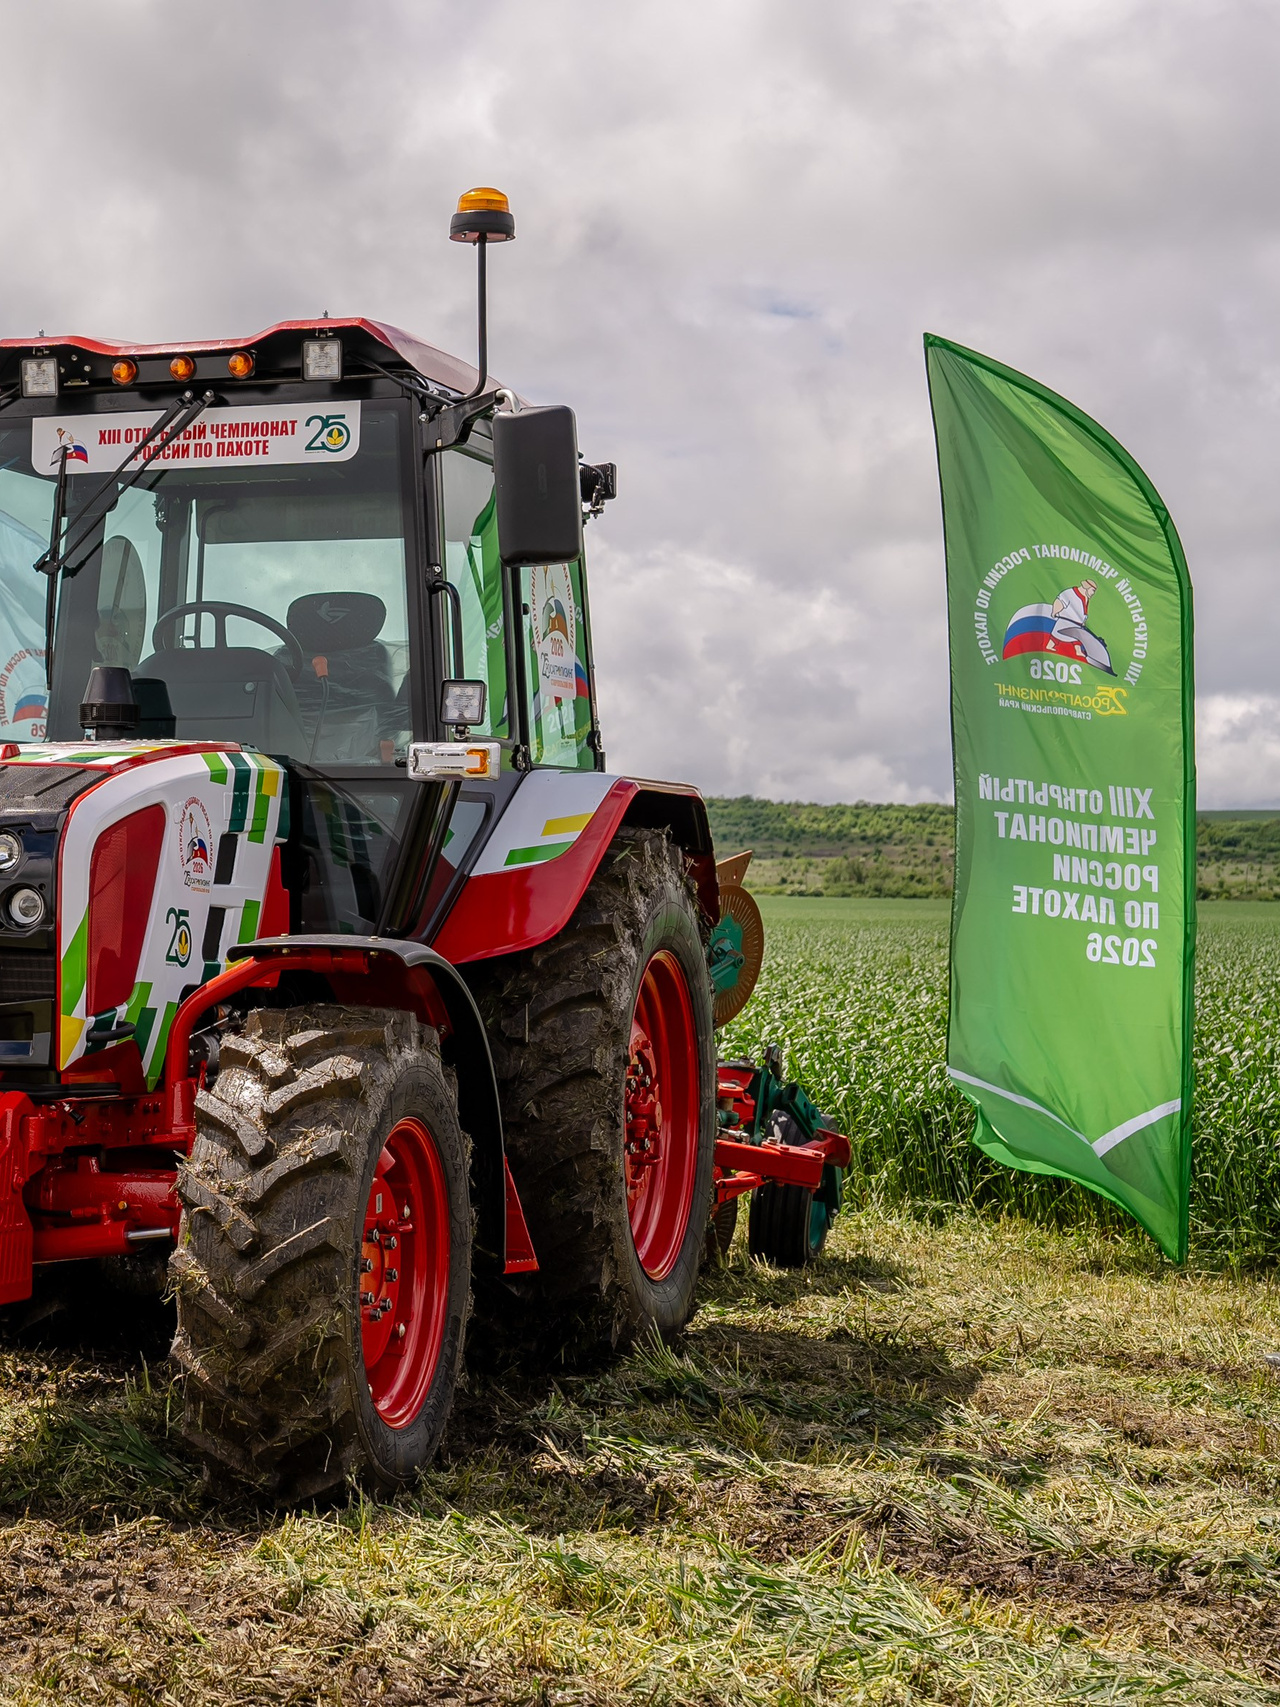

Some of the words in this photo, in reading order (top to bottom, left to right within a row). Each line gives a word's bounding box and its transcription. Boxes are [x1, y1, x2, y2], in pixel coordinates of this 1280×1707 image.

[98, 428, 122, 446] XIII
[210, 419, 298, 439] ЧЕМПИОНАТ
[305, 414, 350, 453] 25
[194, 441, 211, 460] ПО
[215, 439, 269, 458] ПАХОТЕ
[165, 907, 192, 968] 25
